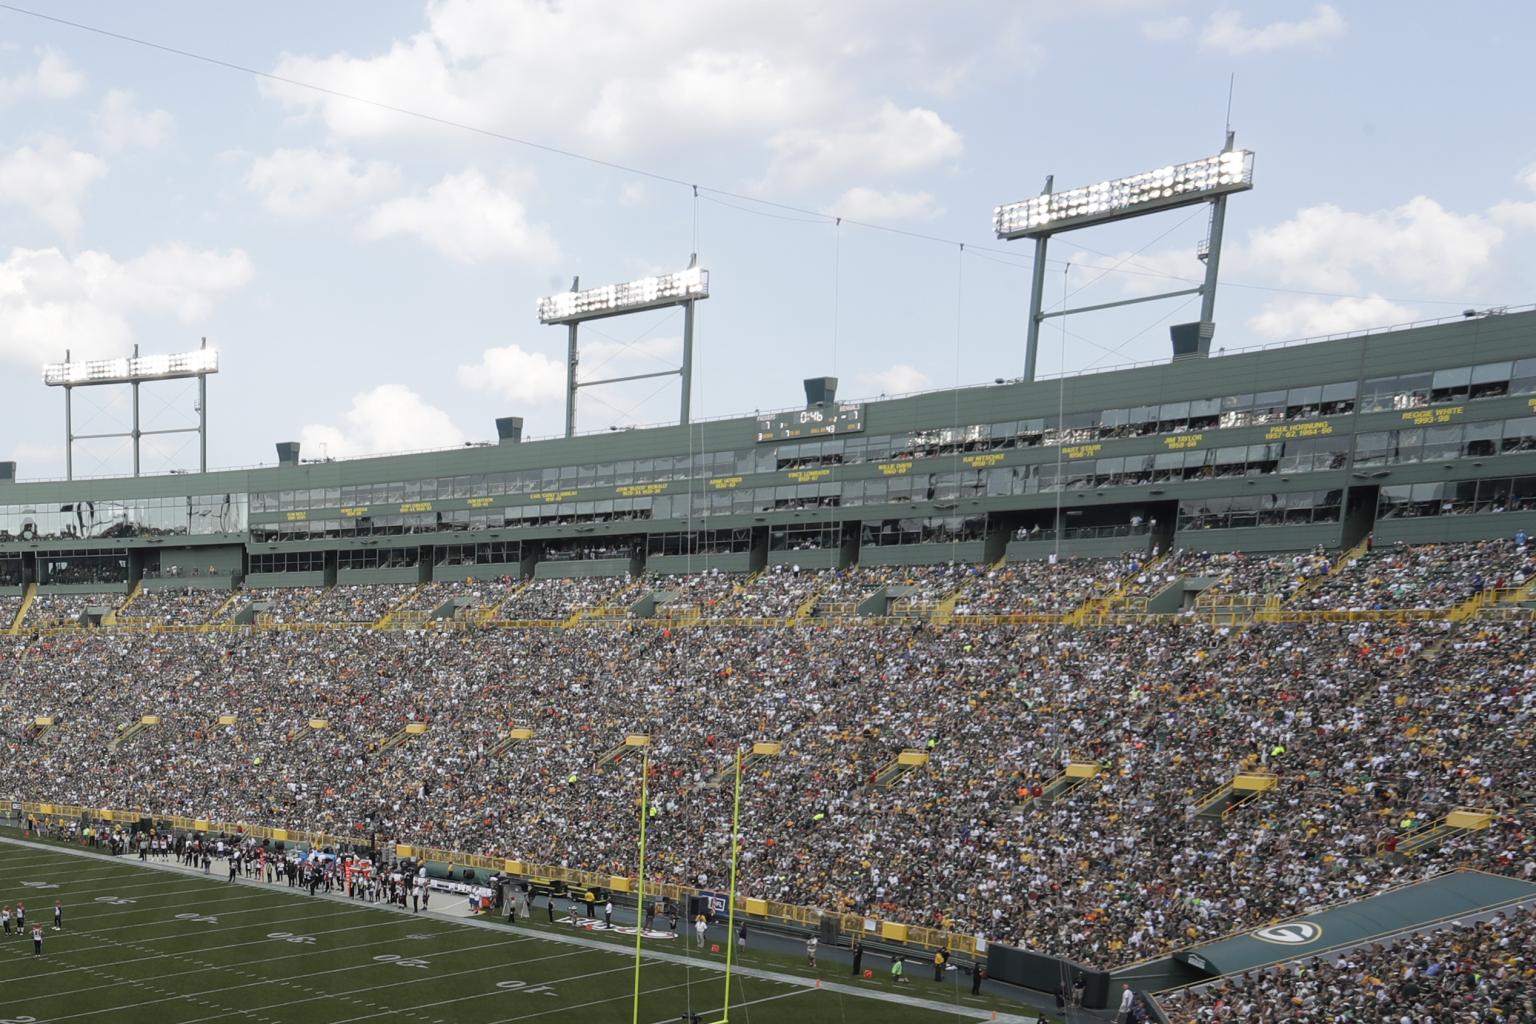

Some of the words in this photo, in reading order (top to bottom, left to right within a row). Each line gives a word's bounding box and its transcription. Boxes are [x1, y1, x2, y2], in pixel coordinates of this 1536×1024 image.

[800, 411, 823, 423] 0:46
[1402, 411, 1432, 419] REGGIE
[1435, 406, 1463, 416] WHITE
